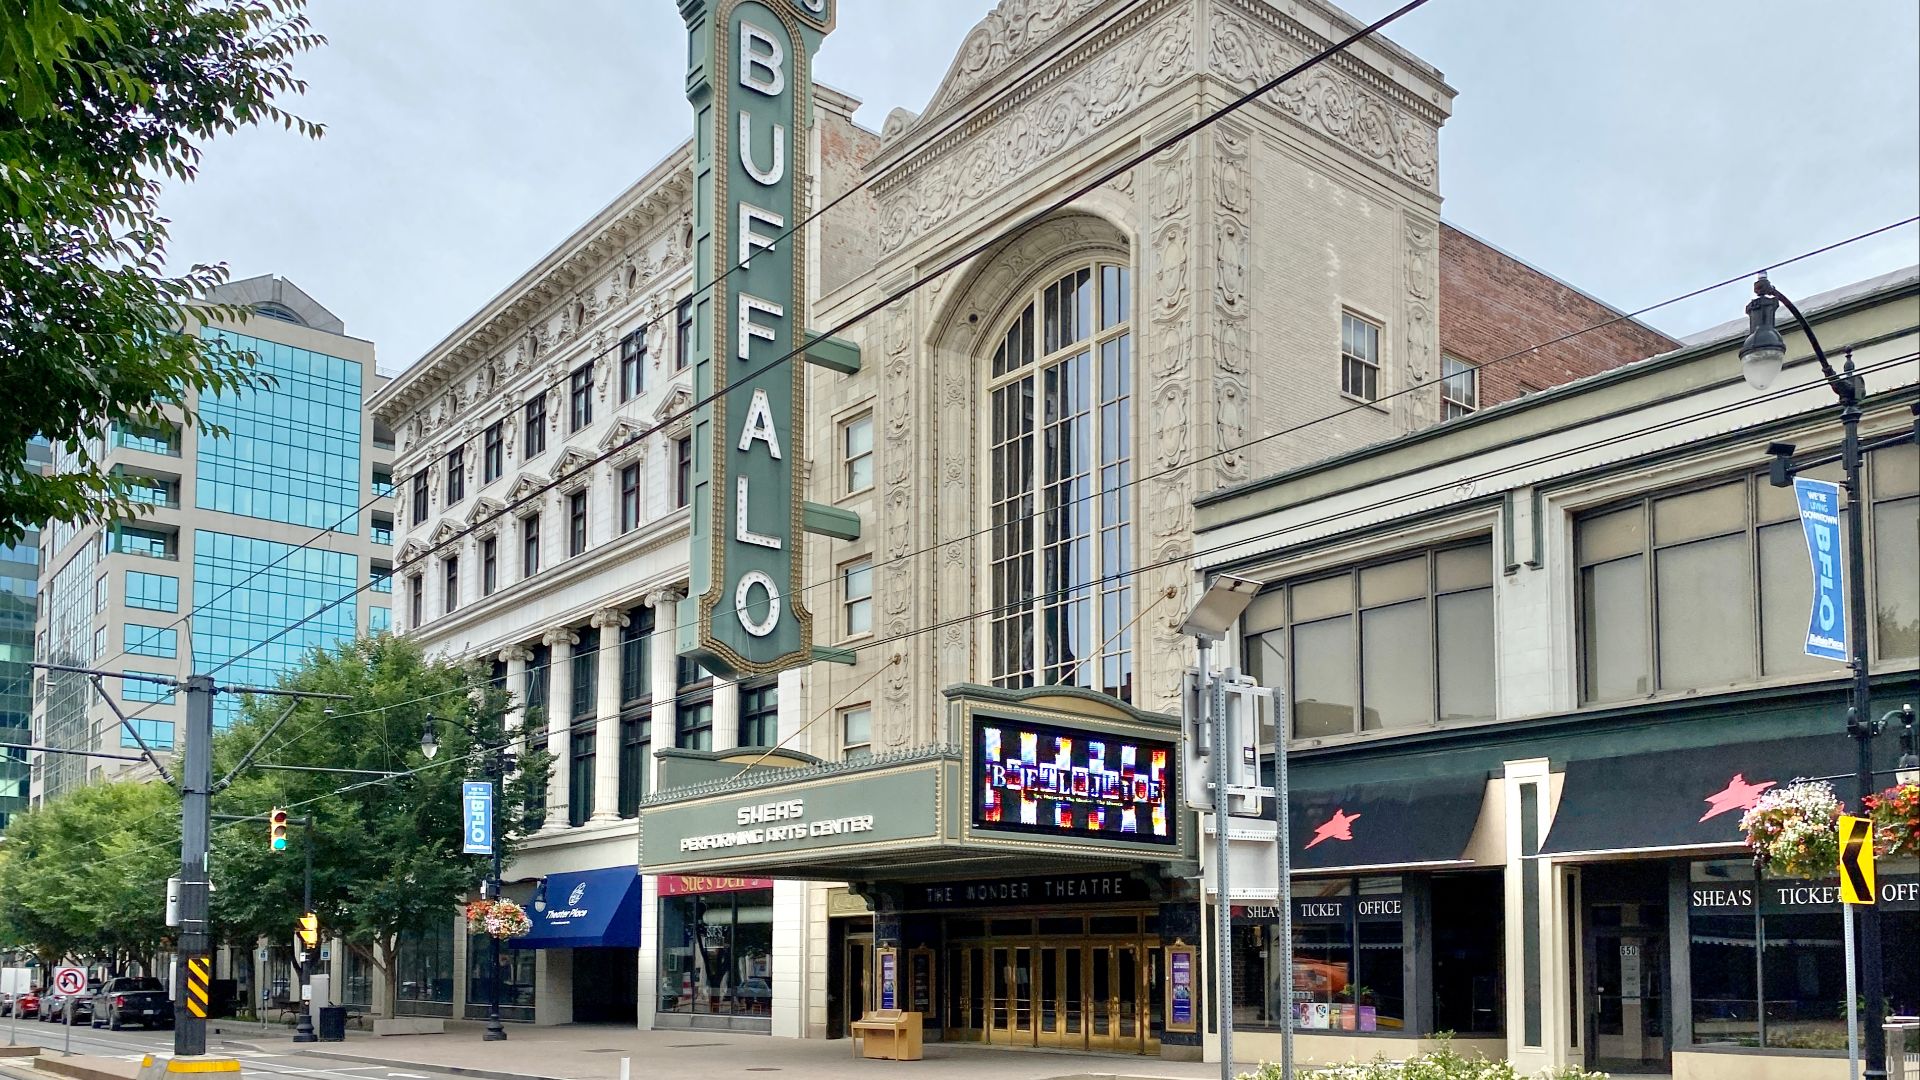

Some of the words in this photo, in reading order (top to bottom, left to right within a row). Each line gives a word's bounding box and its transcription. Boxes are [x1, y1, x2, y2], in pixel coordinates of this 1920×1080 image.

[735, 19, 785, 637] BUFFALO
[1813, 523, 1835, 631] BFLO
[471, 800, 485, 843] BFLO
[680, 828, 764, 852] PERFORMING
[765, 823, 807, 843] ARTS
[809, 815, 874, 838] CENTER
[926, 888, 953, 902] THE
[966, 882, 1029, 900] WONDER
[1044, 877, 1123, 897] THEATRE
[1692, 889, 1752, 907] SHEA'S
[1881, 883, 1919, 902] OFF
[1300, 903, 1342, 917] TICKET
[1358, 900, 1402, 915] OFFICE
